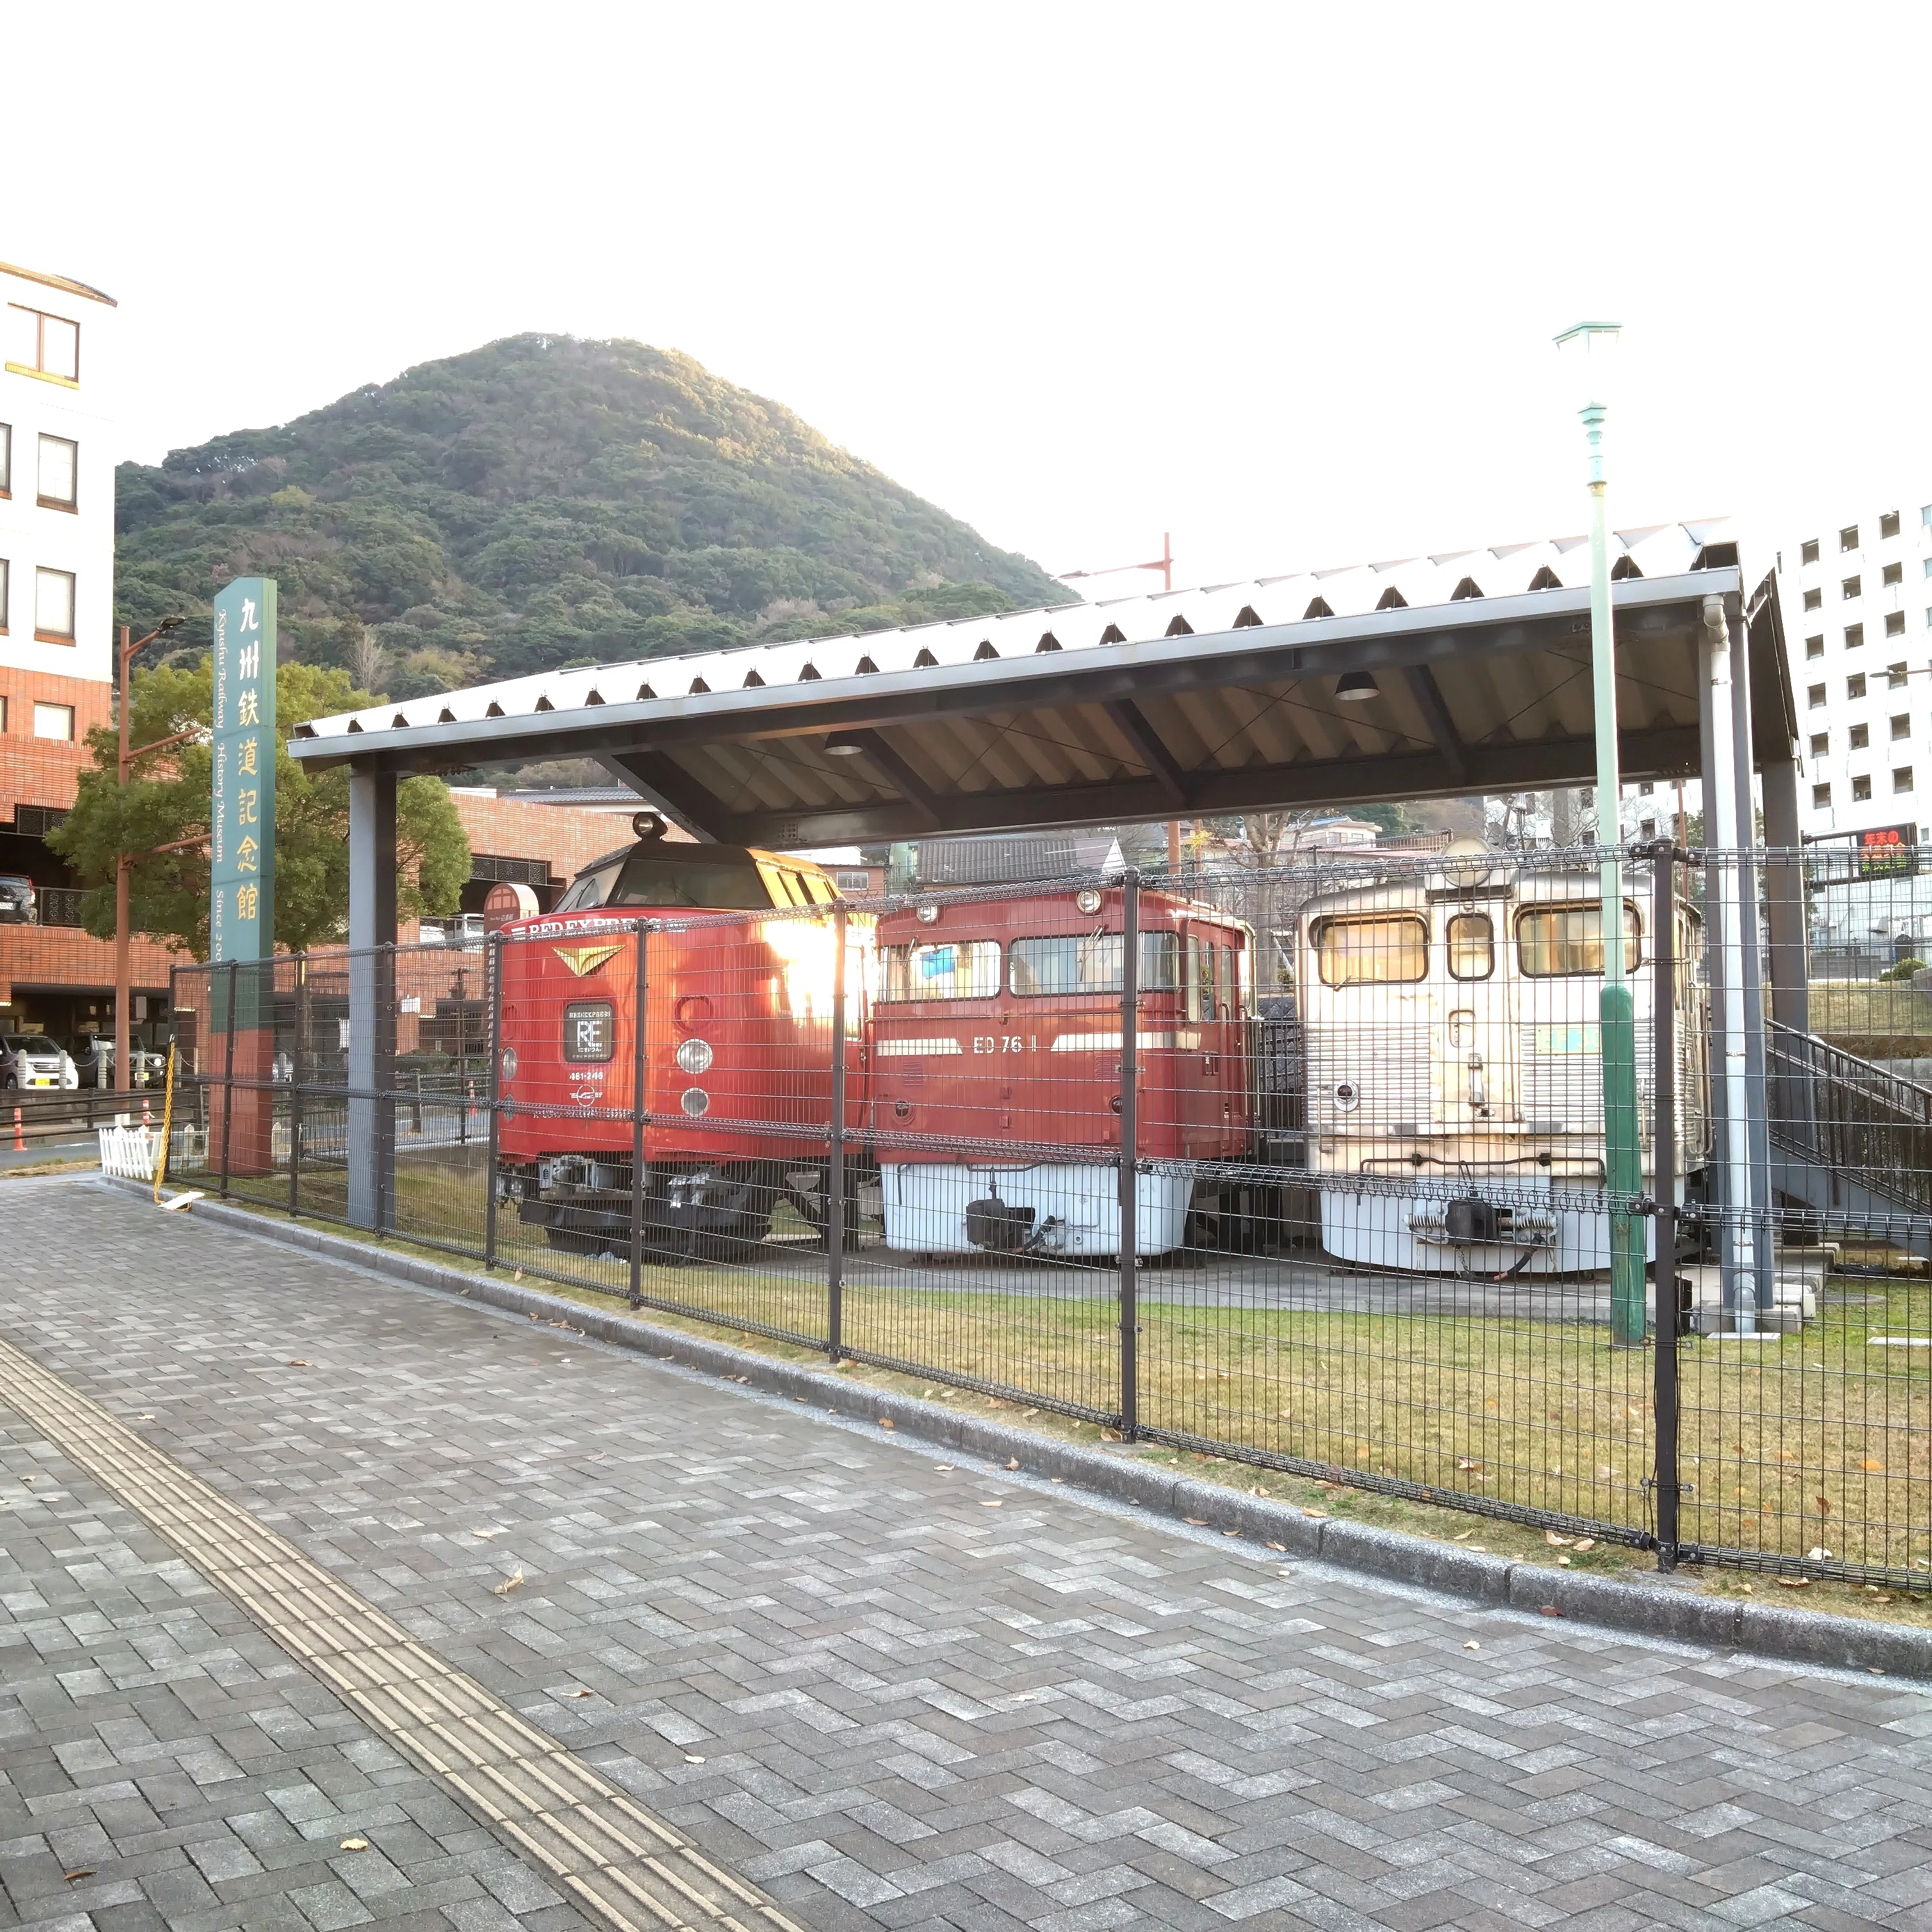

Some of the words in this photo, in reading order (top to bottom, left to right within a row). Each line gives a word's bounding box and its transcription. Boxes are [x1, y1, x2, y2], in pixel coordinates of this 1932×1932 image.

[215, 609, 228, 666] Kyushu
[213, 667, 227, 729] Railway
[212, 742, 227, 798] History
[238, 598, 259, 921] 九州鉄道記念館
[217, 801, 225, 864] Museum
[216, 889, 224, 928] Since
[577, 1020, 602, 1047] RE
[974, 1036, 994, 1054] ED
[1001, 1036, 1022, 1052] 76
